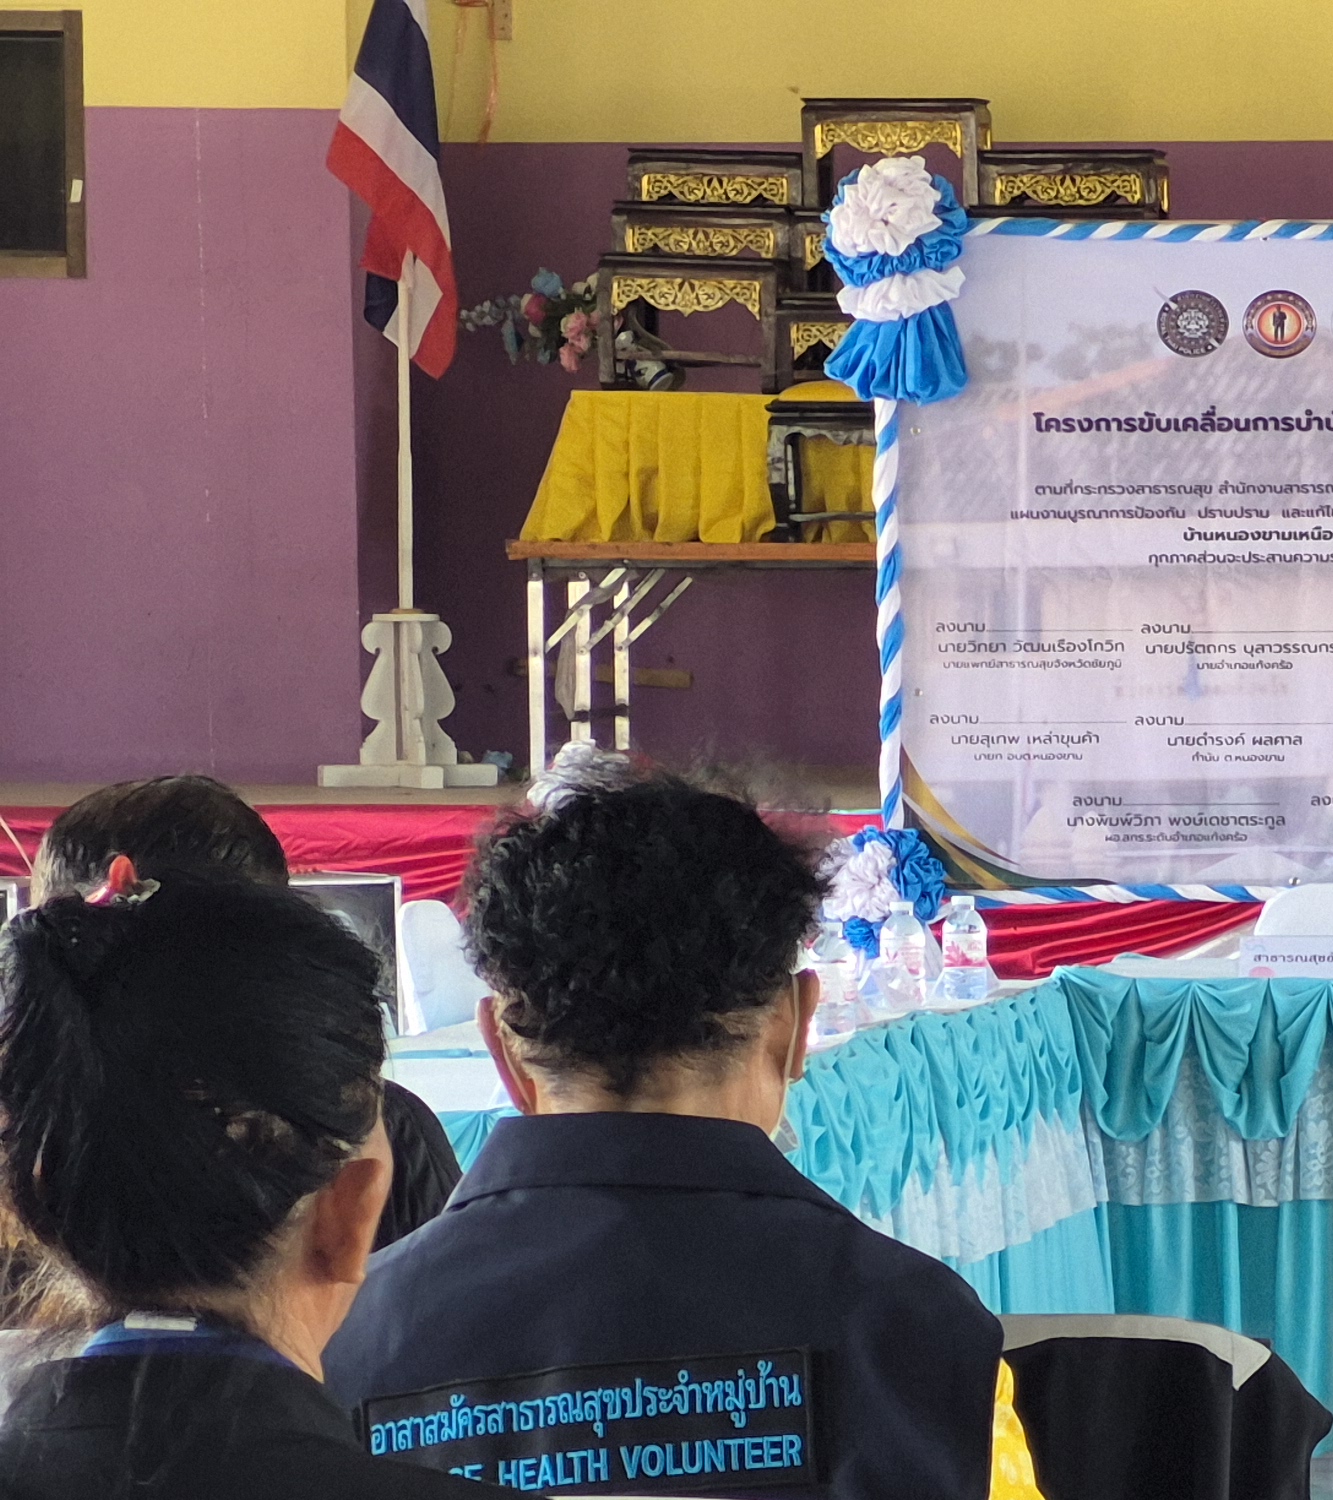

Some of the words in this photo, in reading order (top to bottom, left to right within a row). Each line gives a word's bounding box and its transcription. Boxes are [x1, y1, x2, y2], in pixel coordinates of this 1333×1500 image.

[1010, 505, 1186, 523] แผนงานบูรณาการป้องกัน
[1197, 505, 1270, 519] ปราบปราม
[936, 622, 985, 633] ลงนาม
[1141, 623, 1191, 634] ลงนาม
[938, 640, 1006, 653] นายวิทยา
[929, 714, 980, 725] ลงนาม
[1135, 715, 1185, 726] ลงนาม
[1072, 795, 1123, 807] ลงนาม
[370, 1359, 803, 1456] อาสาสมัครสาธารณสุขประจำหมู่บ้าน
[498, 1447, 610, 1492] HEALTH
[620, 1433, 803, 1481] VOLUNTEER
